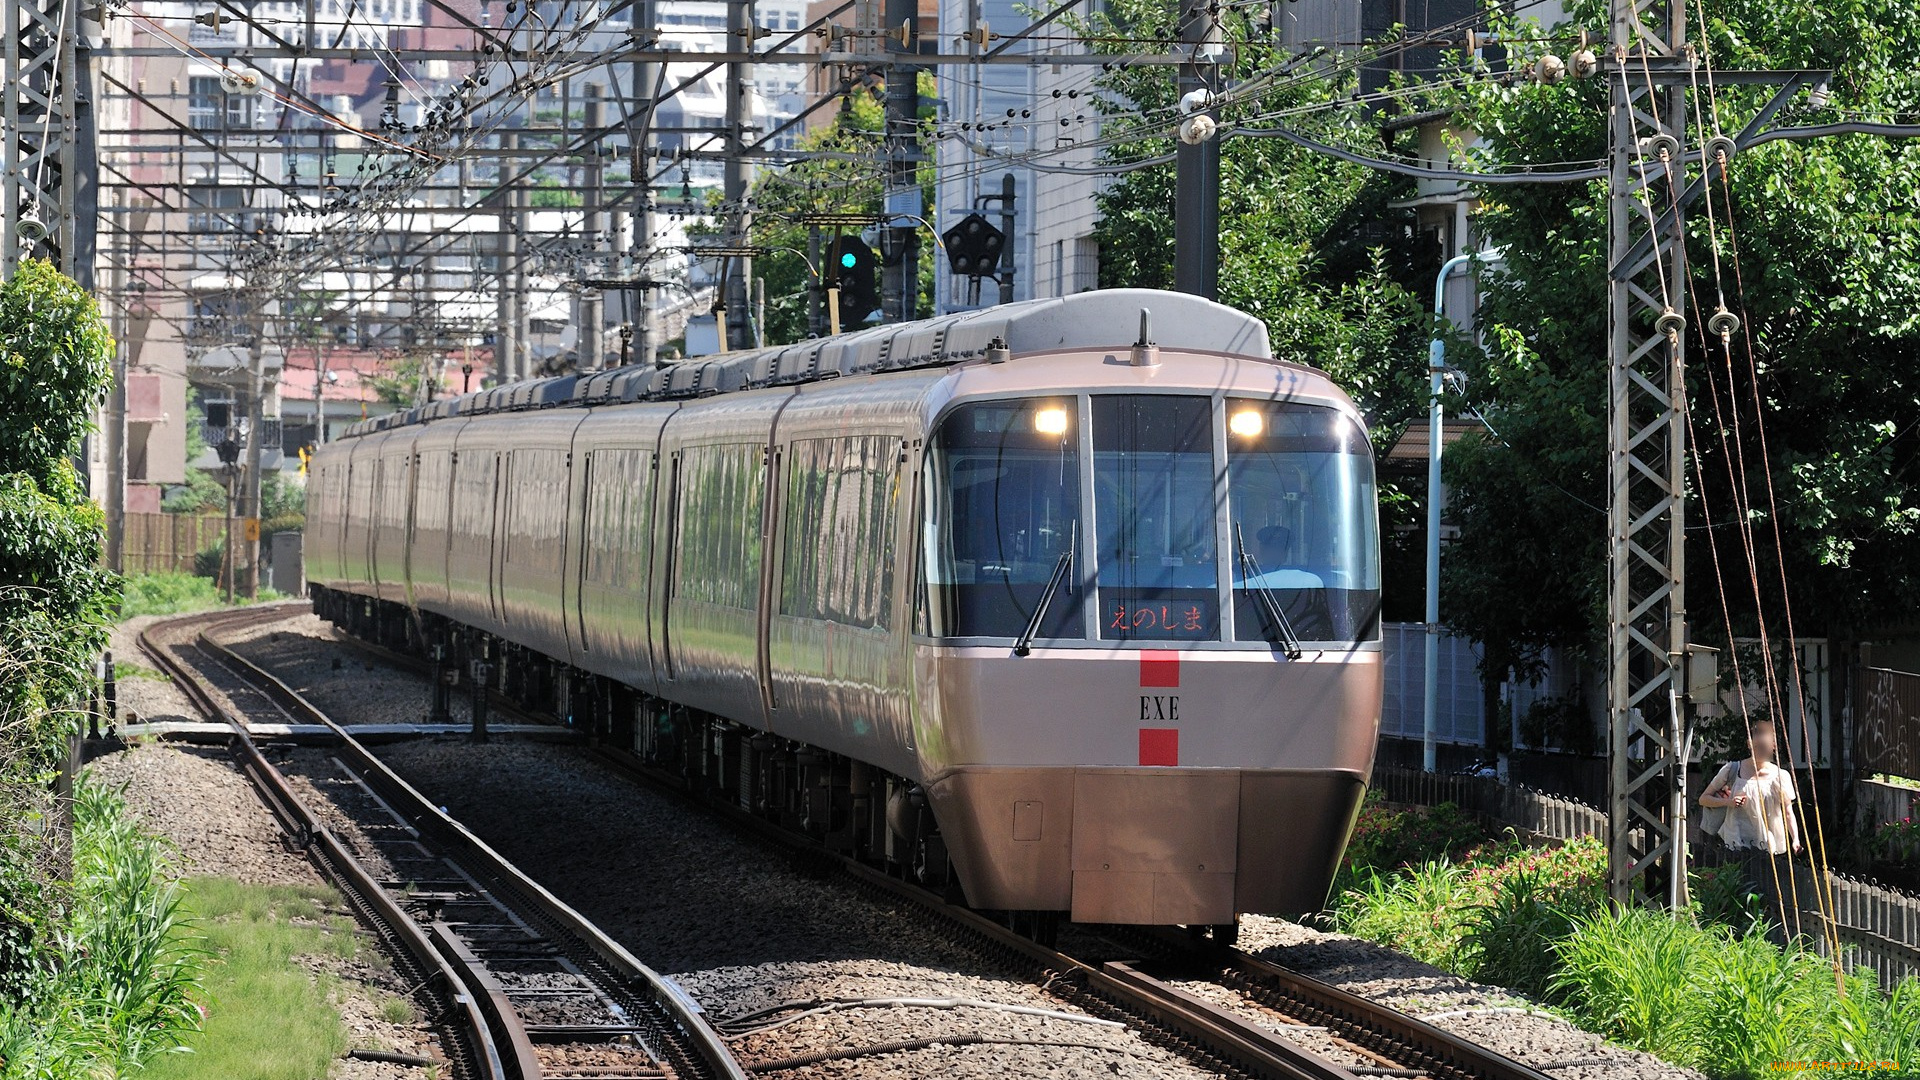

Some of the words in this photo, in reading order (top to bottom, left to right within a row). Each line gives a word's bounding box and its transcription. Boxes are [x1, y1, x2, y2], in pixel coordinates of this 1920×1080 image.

[1111, 605, 1202, 630] えのしま
[1140, 696, 1179, 720] EXE
